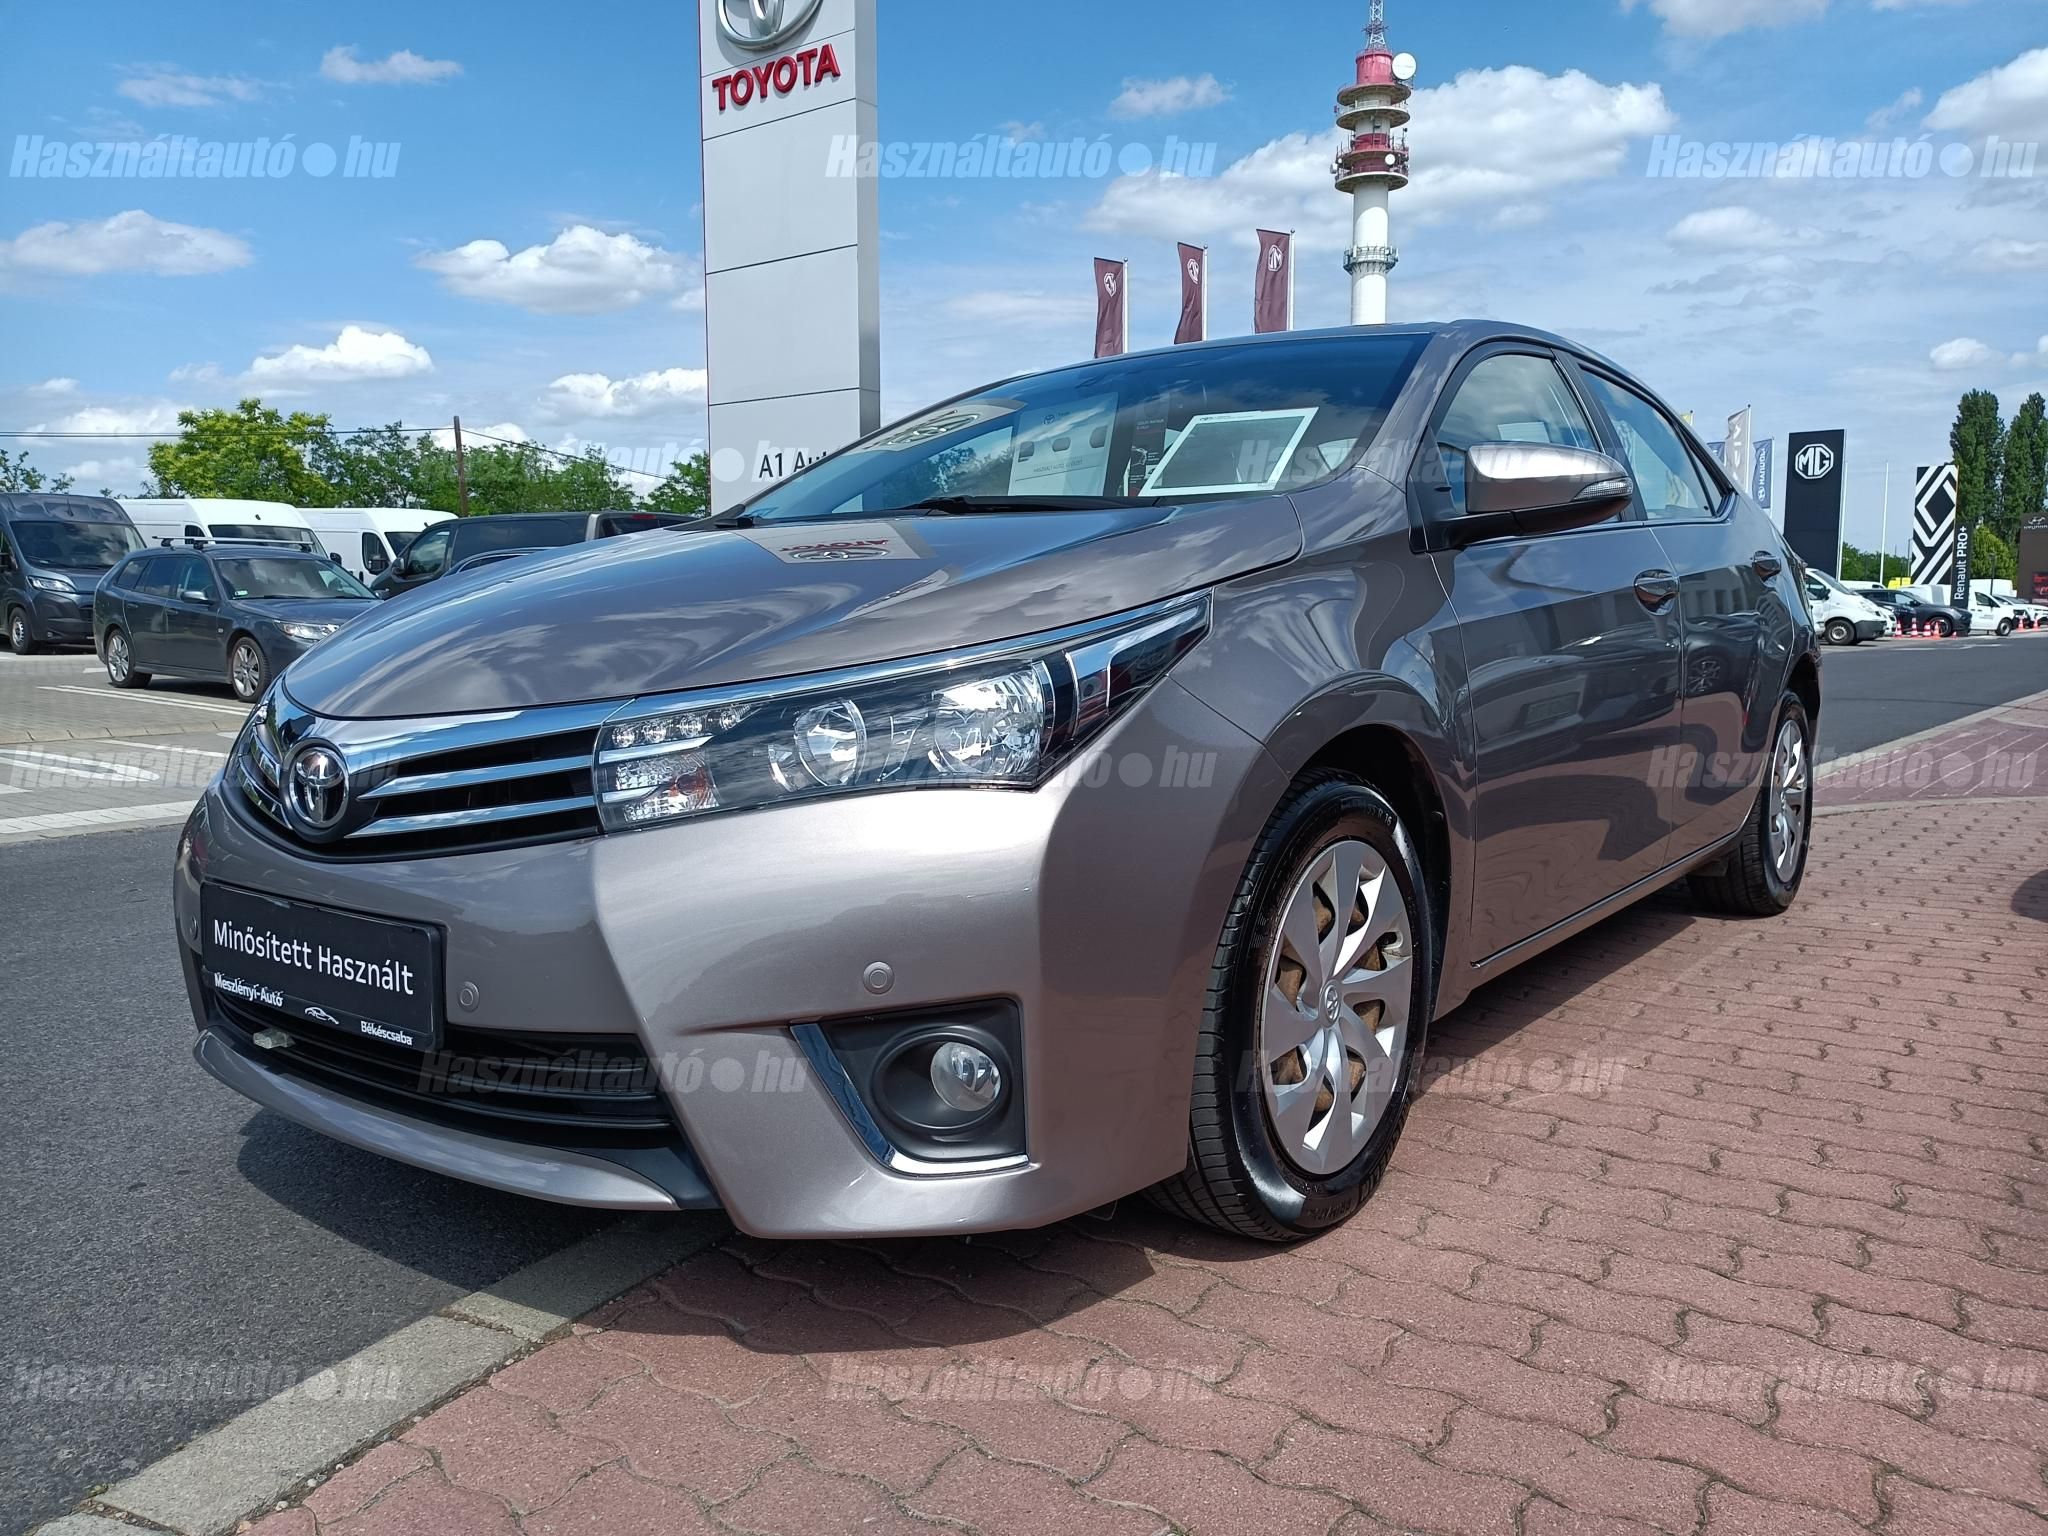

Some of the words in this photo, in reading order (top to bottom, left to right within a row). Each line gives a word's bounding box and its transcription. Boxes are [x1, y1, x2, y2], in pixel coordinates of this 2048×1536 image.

[712, 43, 841, 111] TOYOTA
[758, 453, 783, 478] A1
[1798, 446, 1831, 476] MG
[1957, 525, 1968, 558] PRO+
[1954, 560, 1967, 600] Renault
[214, 919, 313, 970] Minősített
[318, 945, 414, 995] Használt
[360, 1020, 413, 1046] Békéscsaba
